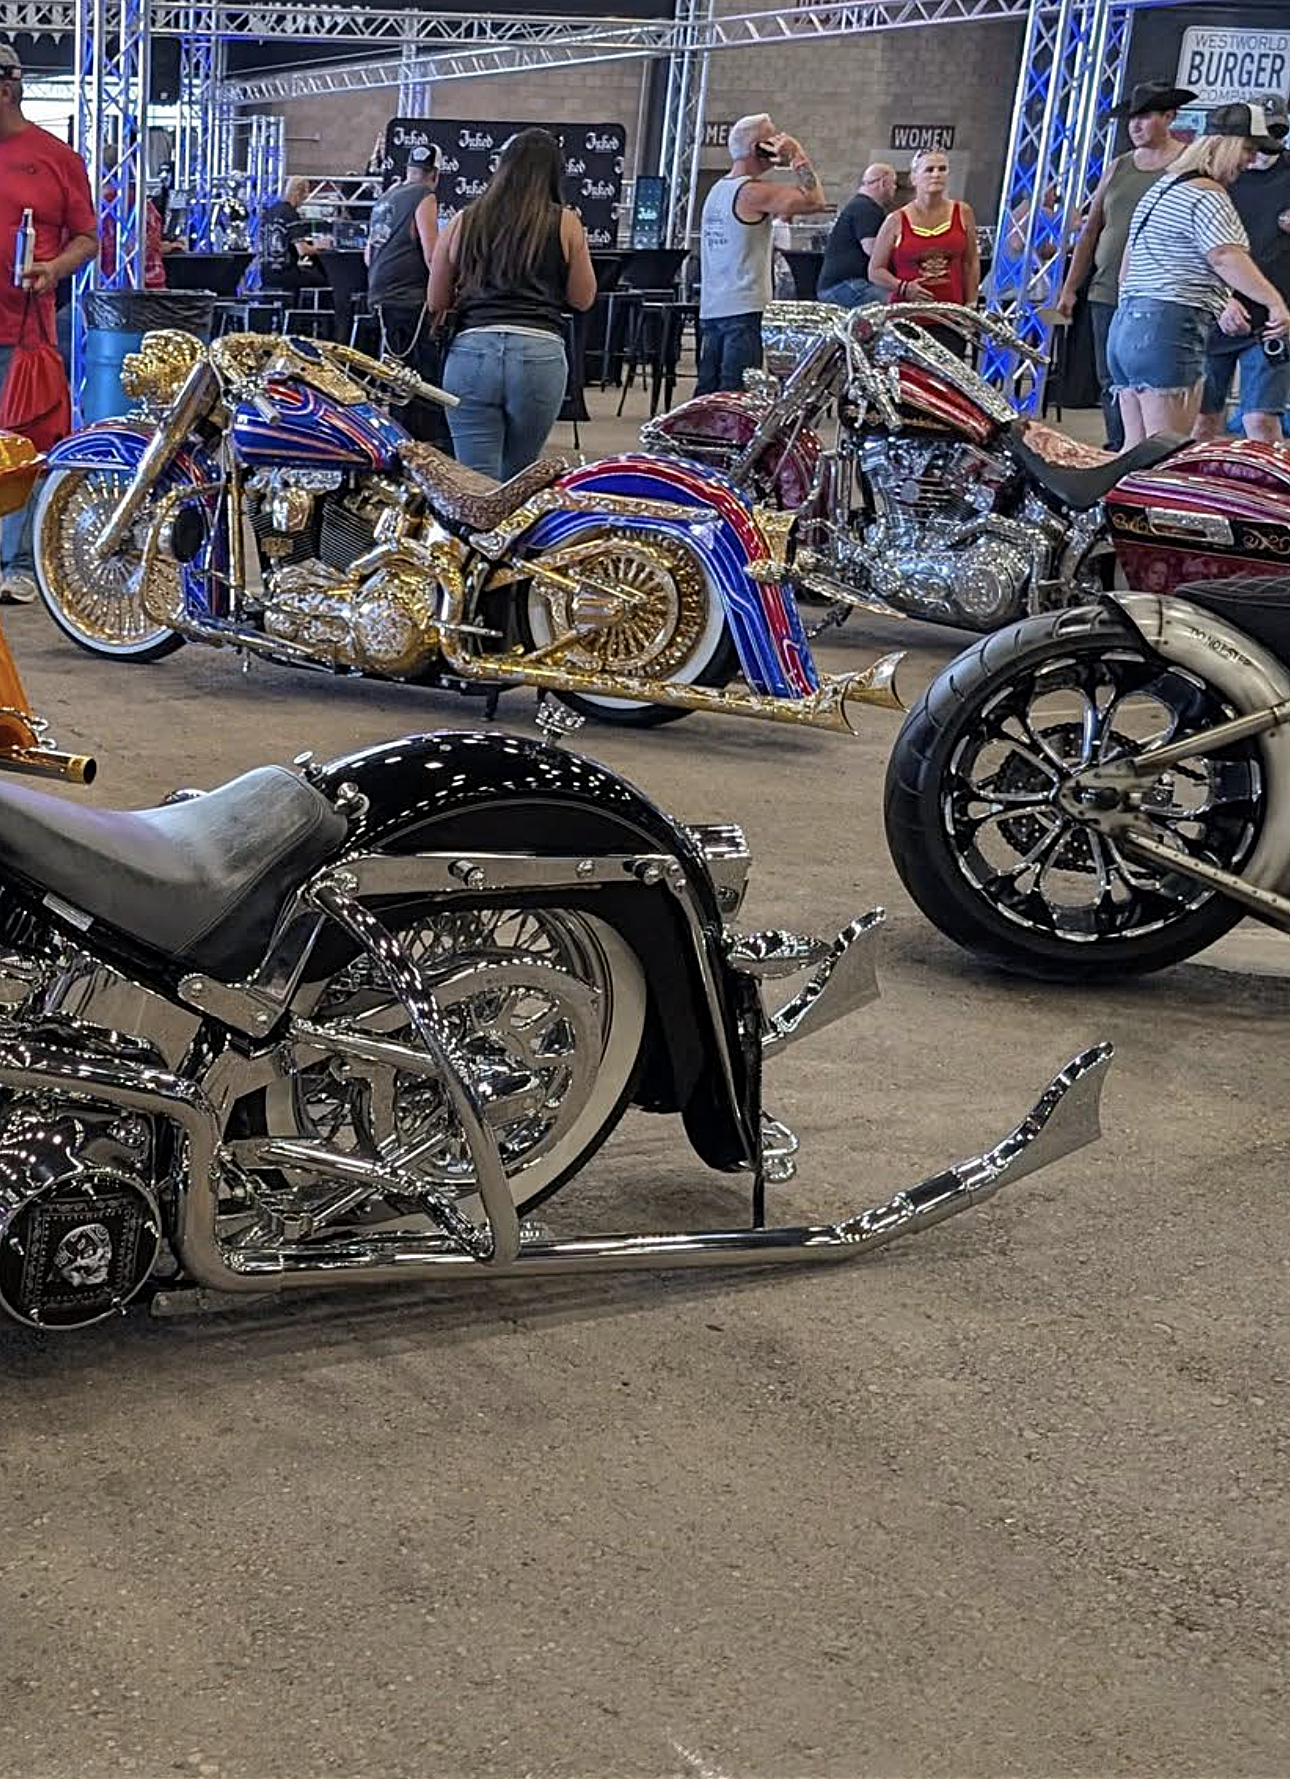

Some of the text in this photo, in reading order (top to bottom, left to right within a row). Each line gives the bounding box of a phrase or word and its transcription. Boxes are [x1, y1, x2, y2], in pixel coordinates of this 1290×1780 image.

[1195, 33, 1288, 51] WESTWORLD
[1187, 51, 1286, 89] BURGER
[1199, 89, 1259, 103] COMPA
[705, 124, 734, 145] ME
[894, 128, 953, 149] WOMEN
